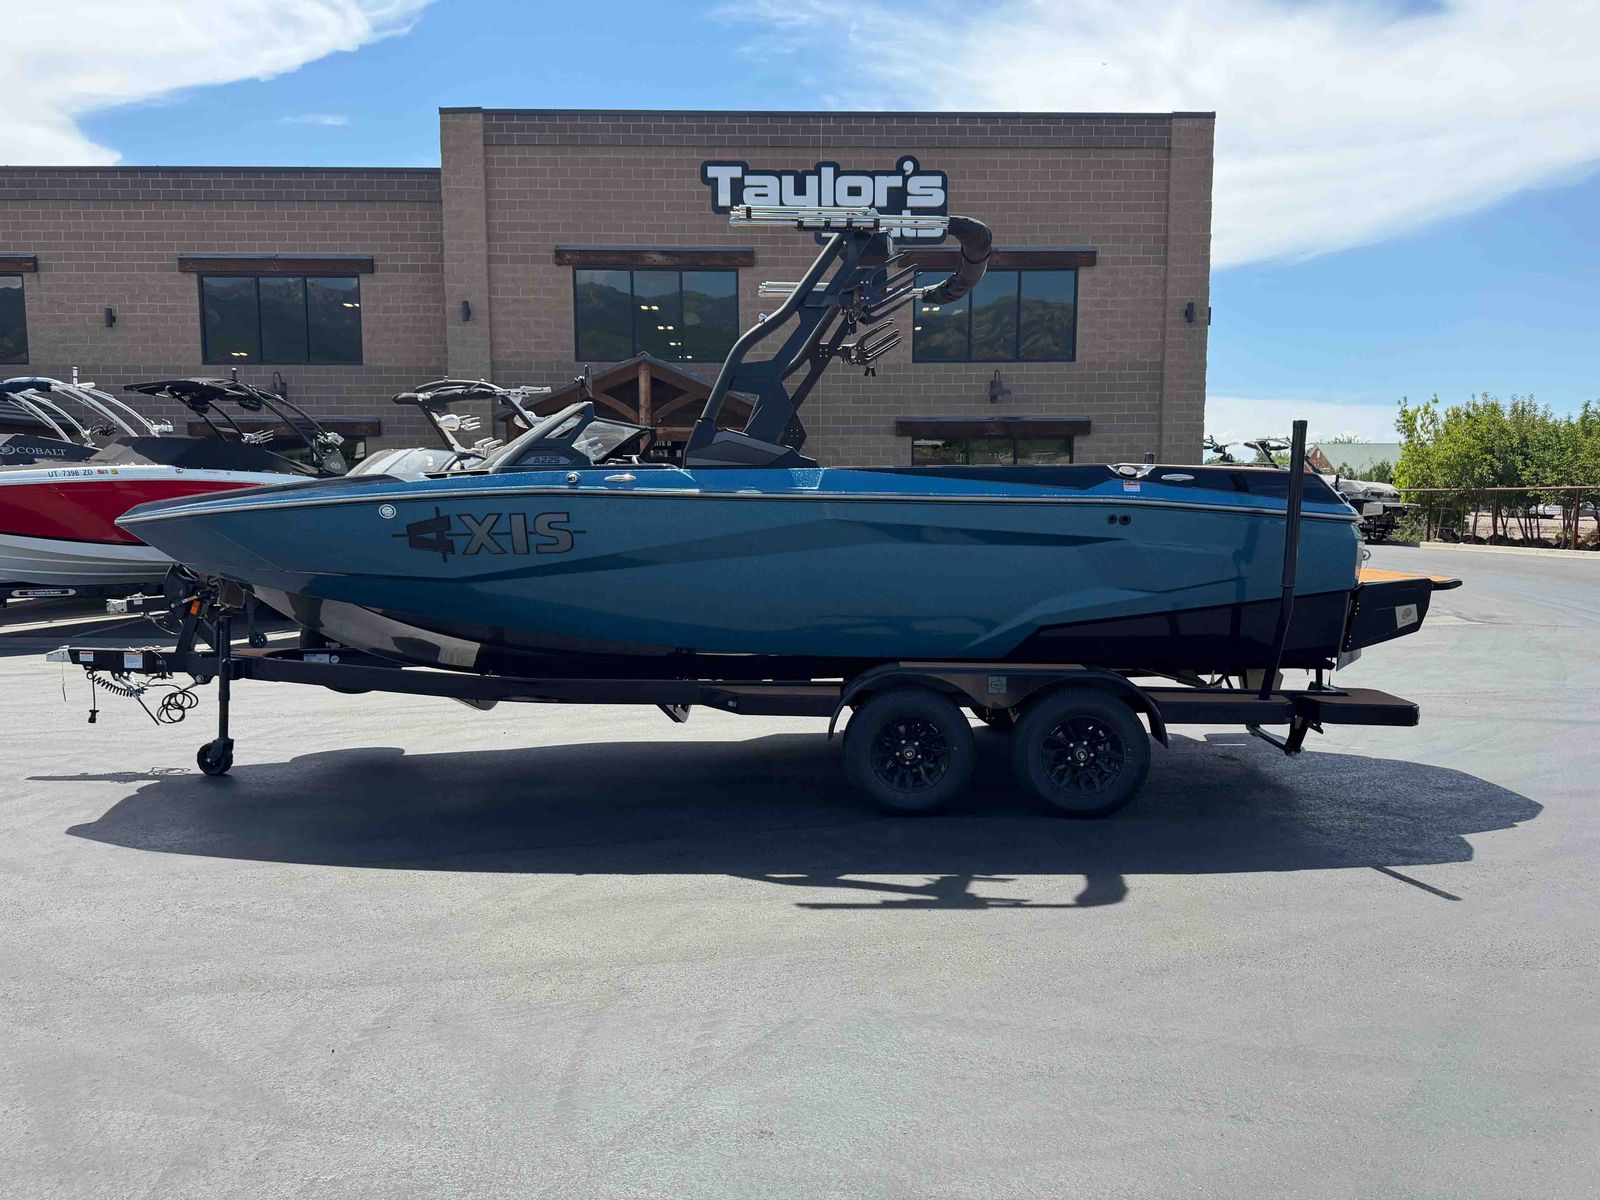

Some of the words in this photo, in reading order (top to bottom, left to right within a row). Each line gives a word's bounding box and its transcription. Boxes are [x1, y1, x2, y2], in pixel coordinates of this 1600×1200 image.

[706, 160, 946, 208] Taylor's
[16, 446, 67, 457] COBALT
[533, 456, 561, 464] A225
[47, 470, 58, 478] UT
